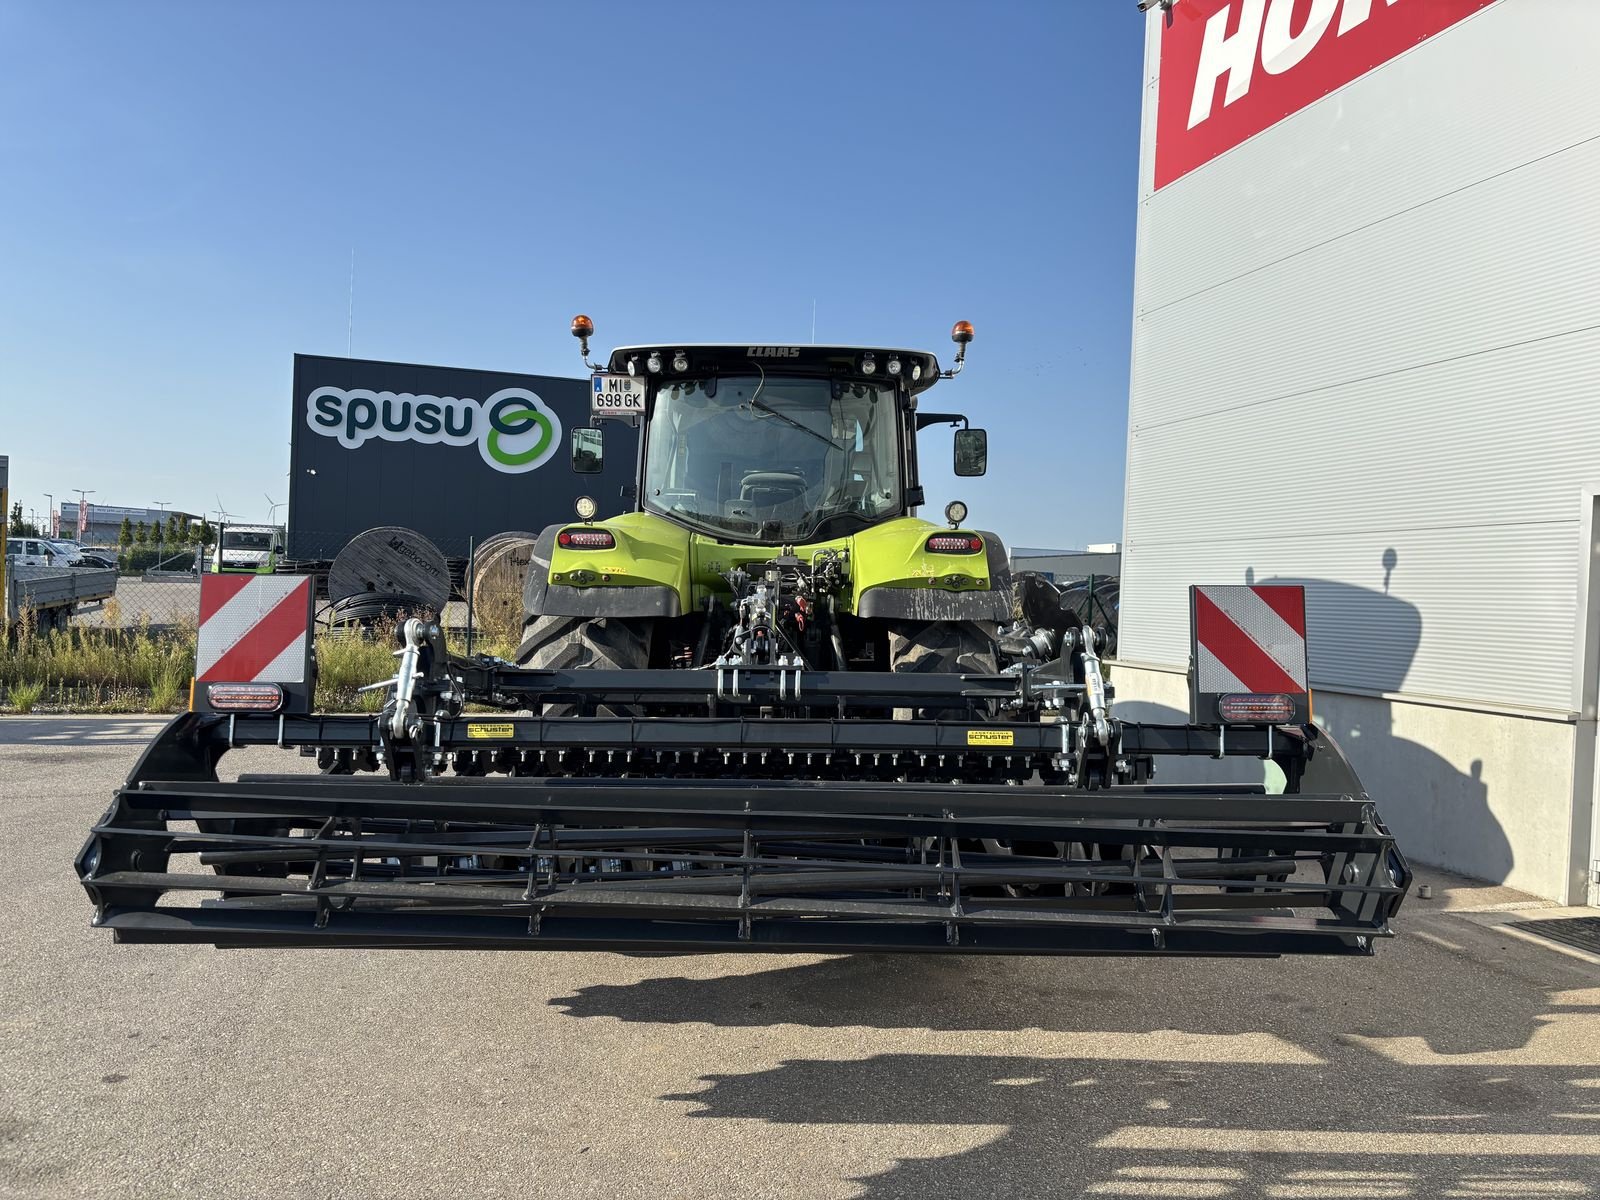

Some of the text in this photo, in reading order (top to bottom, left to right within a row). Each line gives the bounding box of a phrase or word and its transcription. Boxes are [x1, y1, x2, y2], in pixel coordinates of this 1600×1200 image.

[746, 346, 801, 357] CLAAS
[609, 379, 622, 392] MI
[596, 393, 641, 407] 698 GK
[315, 394, 473, 440] spusu
